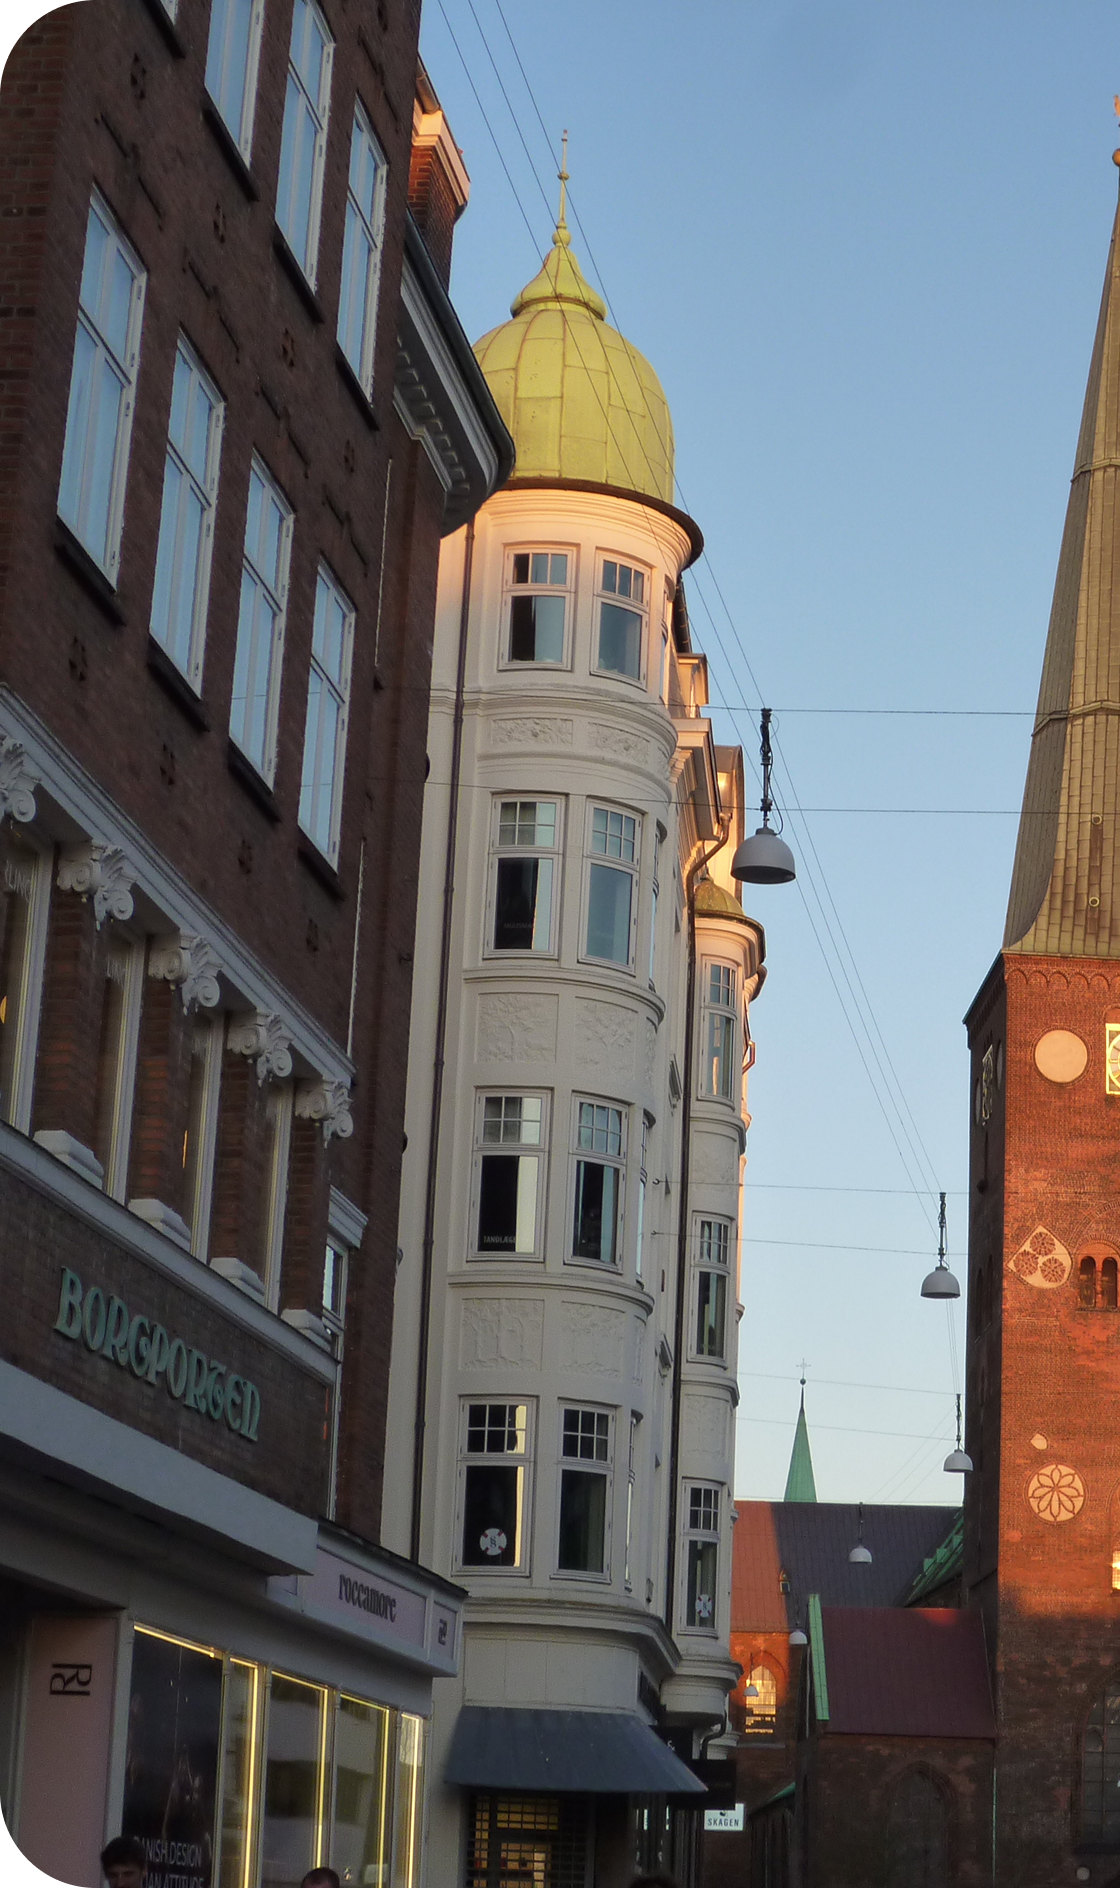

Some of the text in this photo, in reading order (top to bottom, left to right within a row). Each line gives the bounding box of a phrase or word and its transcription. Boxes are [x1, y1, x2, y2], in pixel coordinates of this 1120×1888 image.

[53, 1265, 261, 1442] BORGPORTEN
[338, 1574, 396, 1622] roccamore
[707, 1818, 740, 1827] SKAGEN
[169, 1841, 202, 1868] DESIGN
